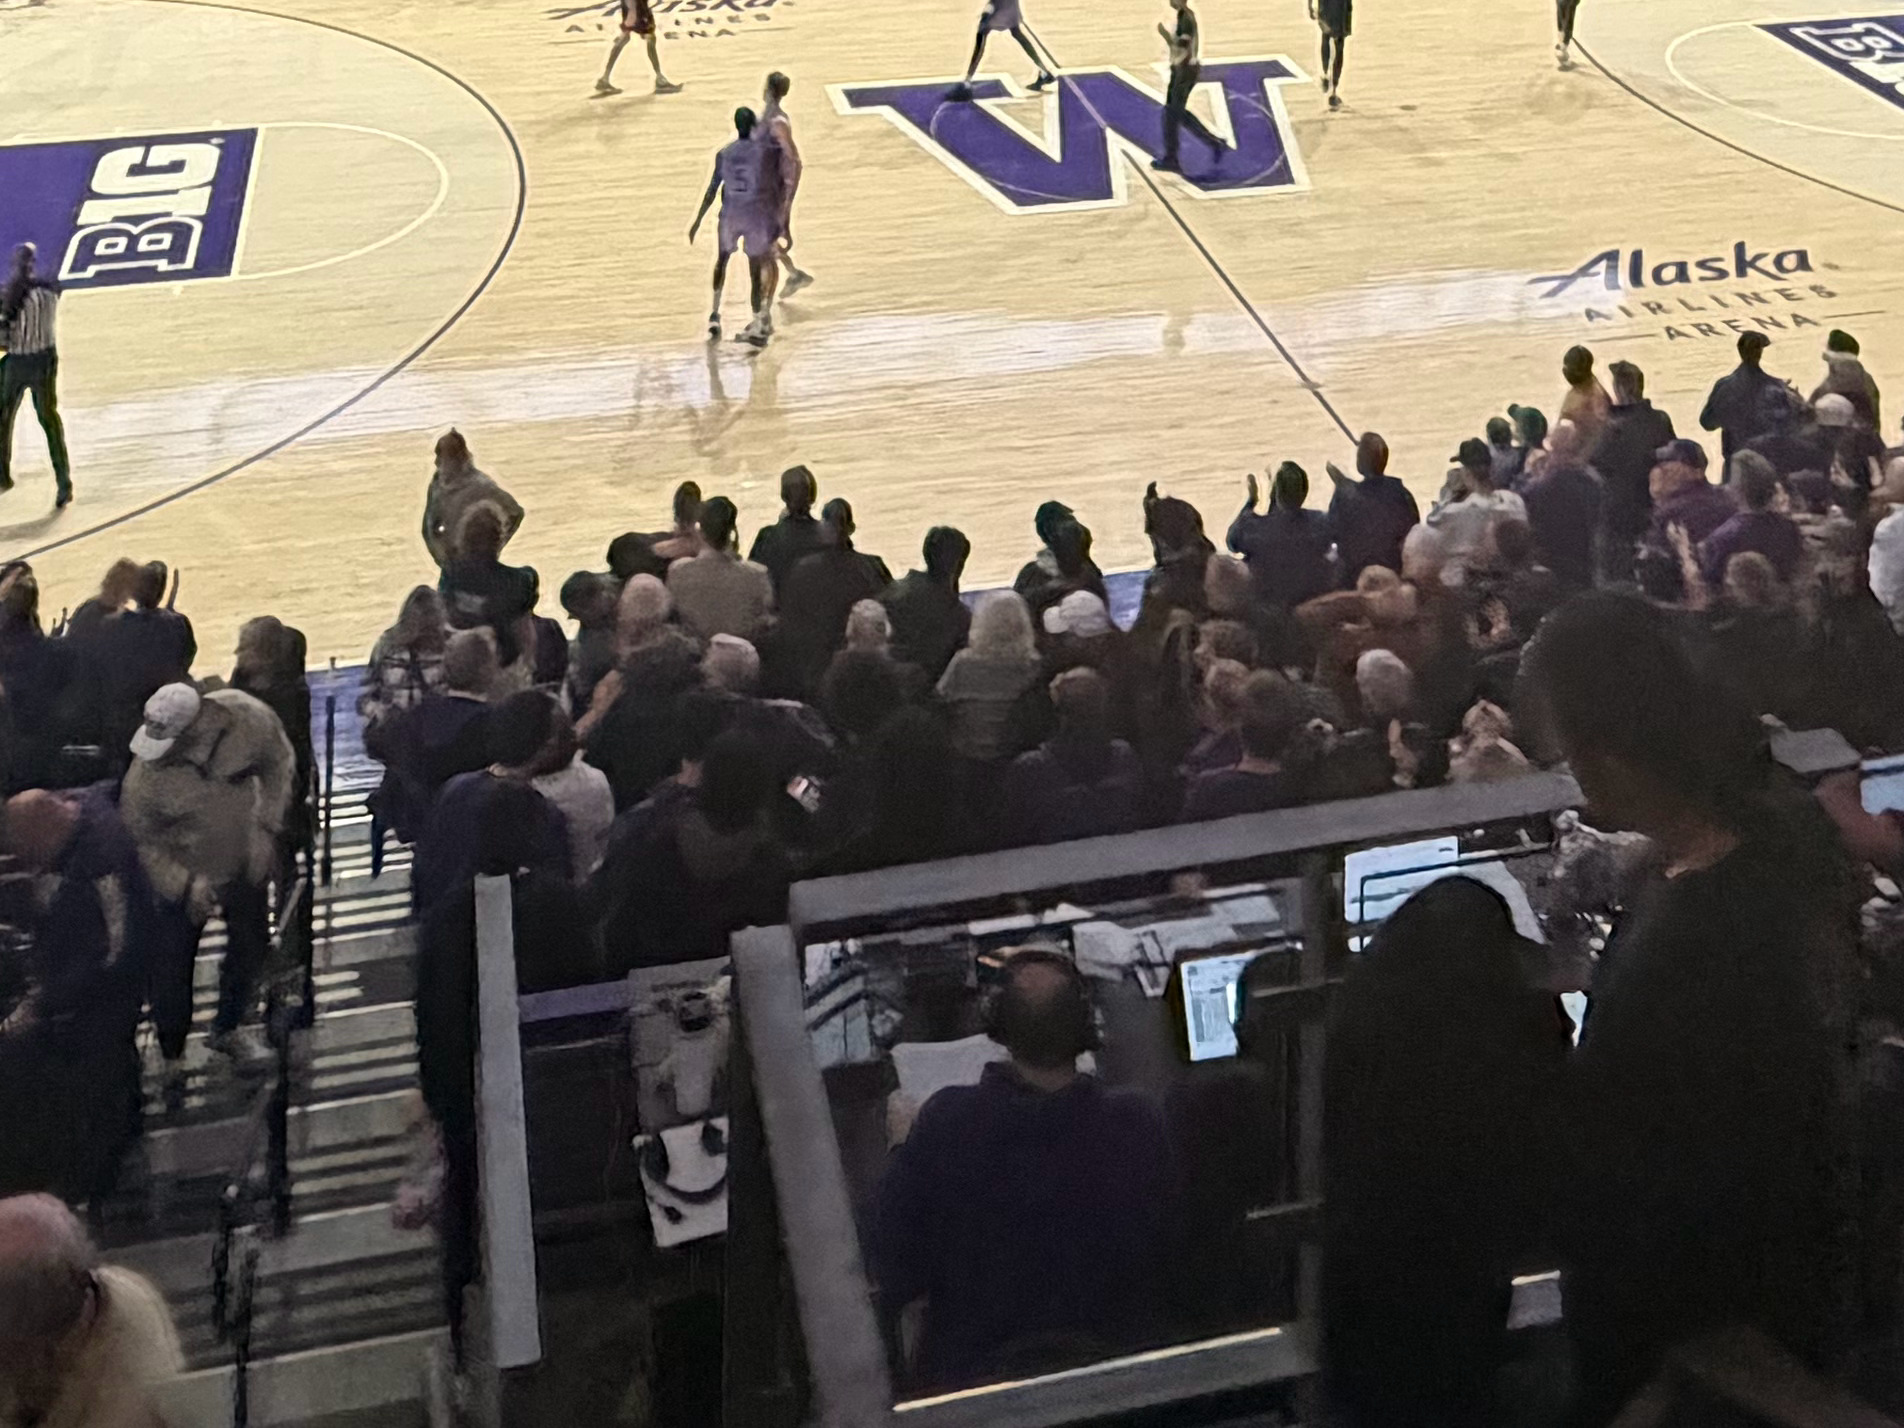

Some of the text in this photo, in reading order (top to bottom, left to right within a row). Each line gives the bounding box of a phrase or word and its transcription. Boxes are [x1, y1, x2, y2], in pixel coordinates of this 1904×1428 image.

[826, 53, 1312, 215] W
[1525, 240, 1814, 299] Alaska
[1583, 284, 1838, 323] AIRLINES
[1663, 312, 1821, 341] ARENA
